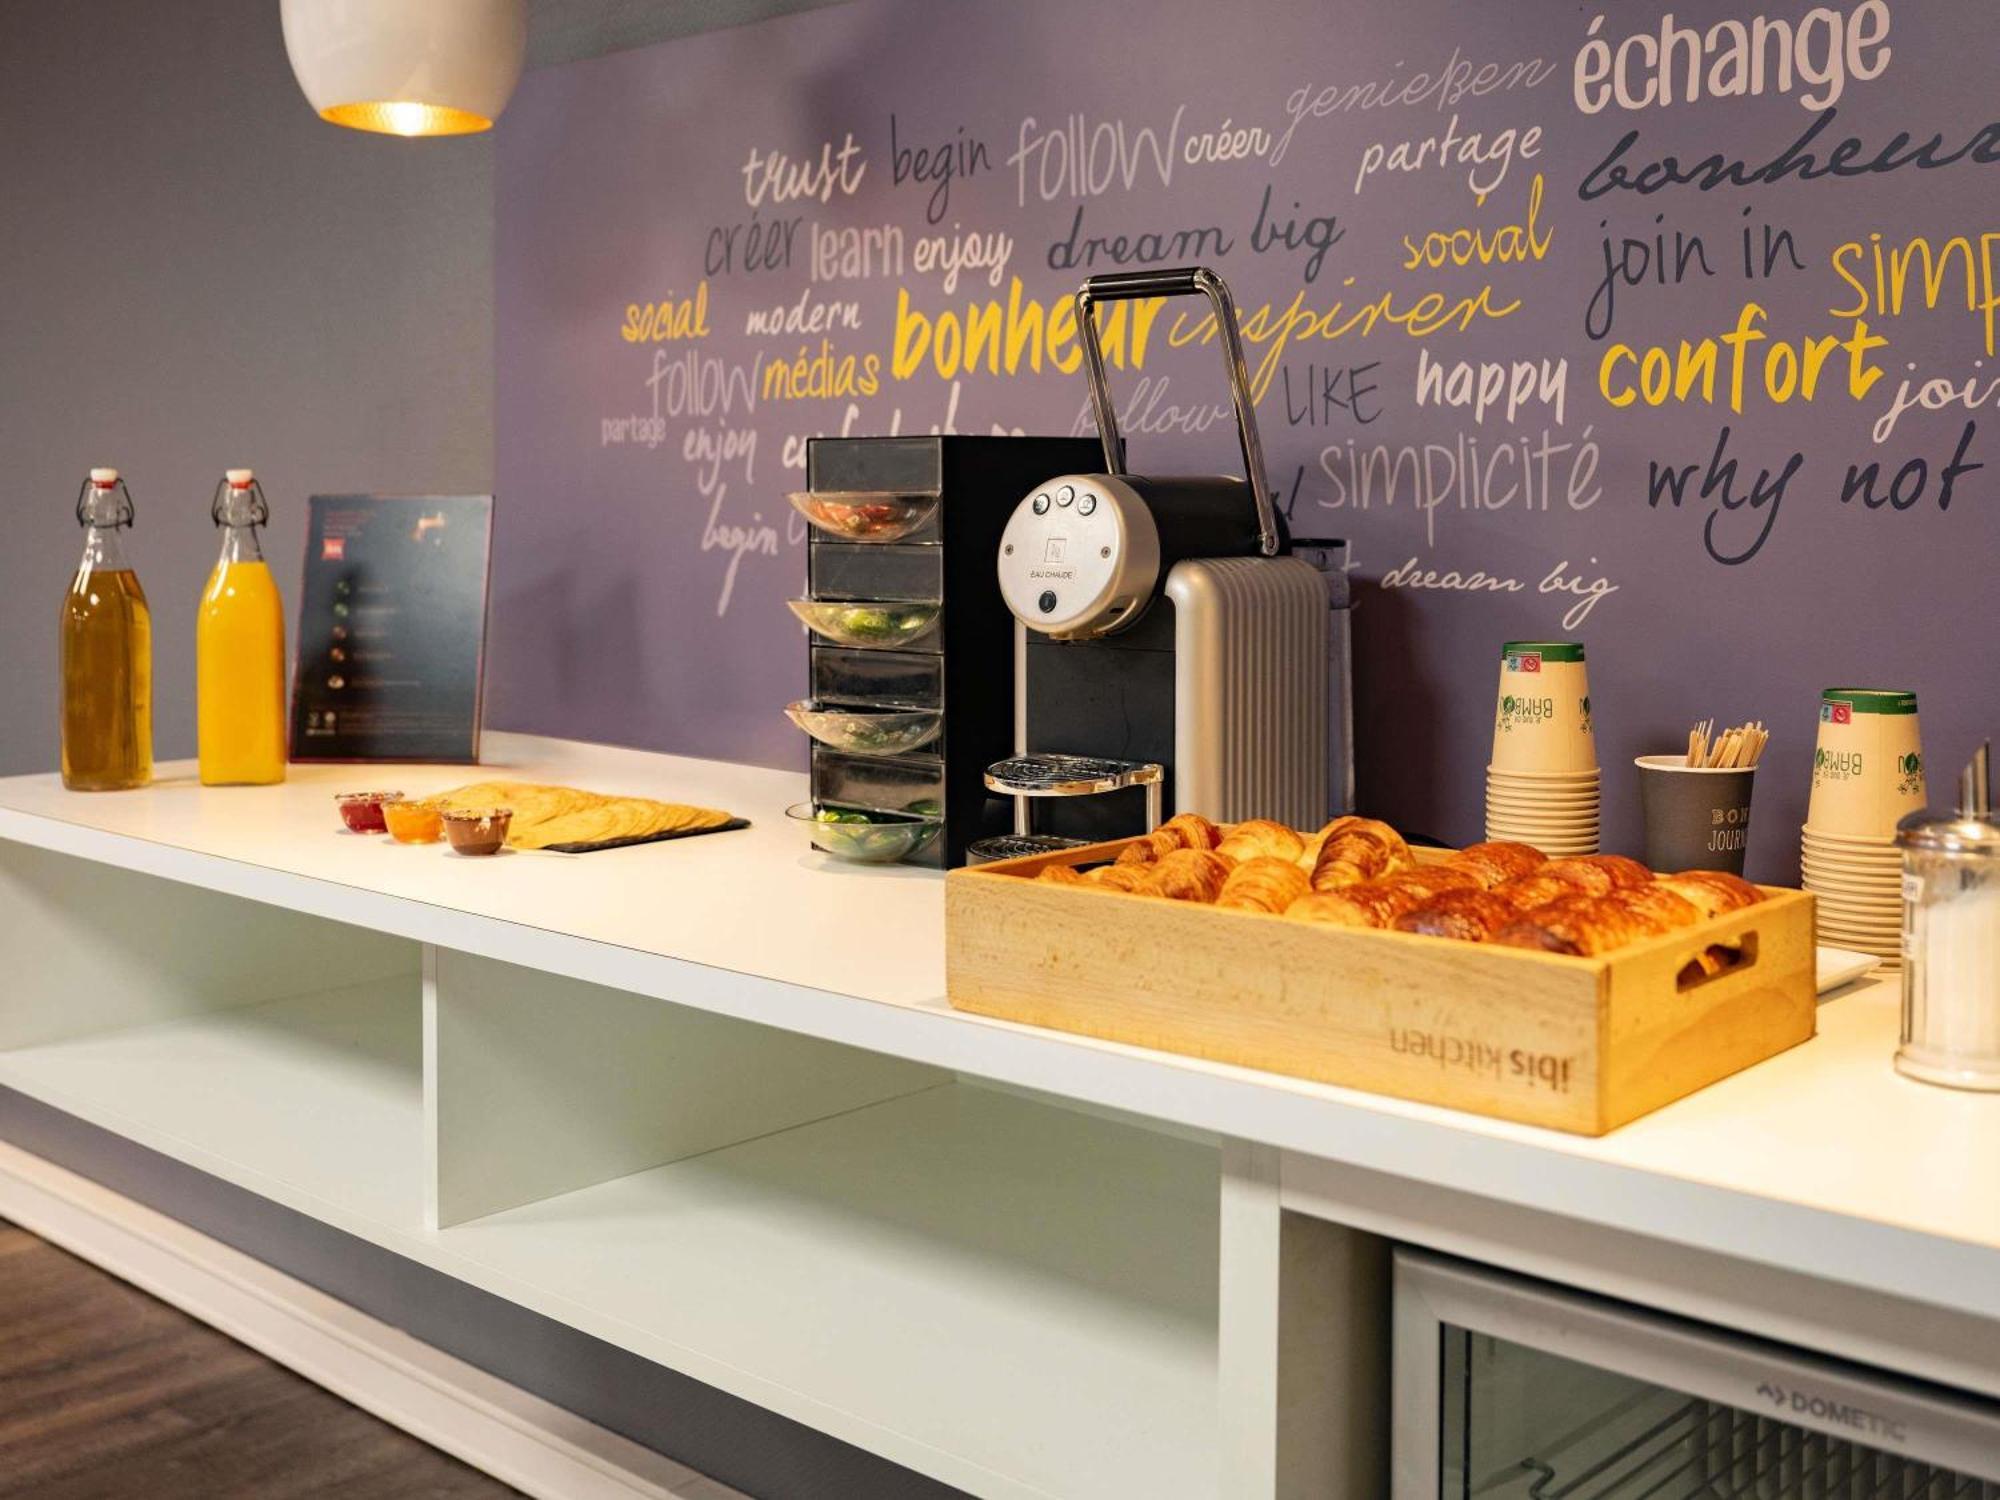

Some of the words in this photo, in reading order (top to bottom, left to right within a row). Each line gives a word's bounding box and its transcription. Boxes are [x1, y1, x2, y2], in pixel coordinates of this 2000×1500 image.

[1574, 0, 1892, 115] échange
[742, 133, 867, 207] trust
[890, 114, 991, 225] begin
[1184, 118, 1272, 165] créer
[1354, 114, 1543, 195] partage
[704, 212, 803, 277] créer
[811, 220, 904, 283] learn
[913, 224, 1013, 295] enjoy
[1047, 205, 1234, 271] dream
[1251, 184, 1346, 283] big
[1404, 173, 1555, 271] social
[621, 280, 710, 343] social
[746, 288, 862, 335] modern
[1585, 212, 1715, 341] join
[1742, 206, 1806, 280] in
[892, 276, 1168, 381] bonheur
[1599, 303, 1889, 415] confort
[762, 339, 881, 400] médias
[1282, 361, 1386, 427] LIKE
[1415, 348, 1569, 427] happy
[1872, 361, 2000, 443] joi
[601, 415, 667, 450] partage
[683, 418, 758, 495] enjoy
[1317, 424, 1603, 548] simplicité
[1648, 426, 1803, 566] why
[1840, 420, 1984, 511] not
[701, 483, 779, 618] begin
[1380, 557, 1525, 592] dream
[1537, 557, 1620, 632] big
[1389, 1028, 1501, 1080] kitchen
[1509, 1049, 1570, 1094] ibis
[1791, 1392, 1907, 1443] DOMETIC
